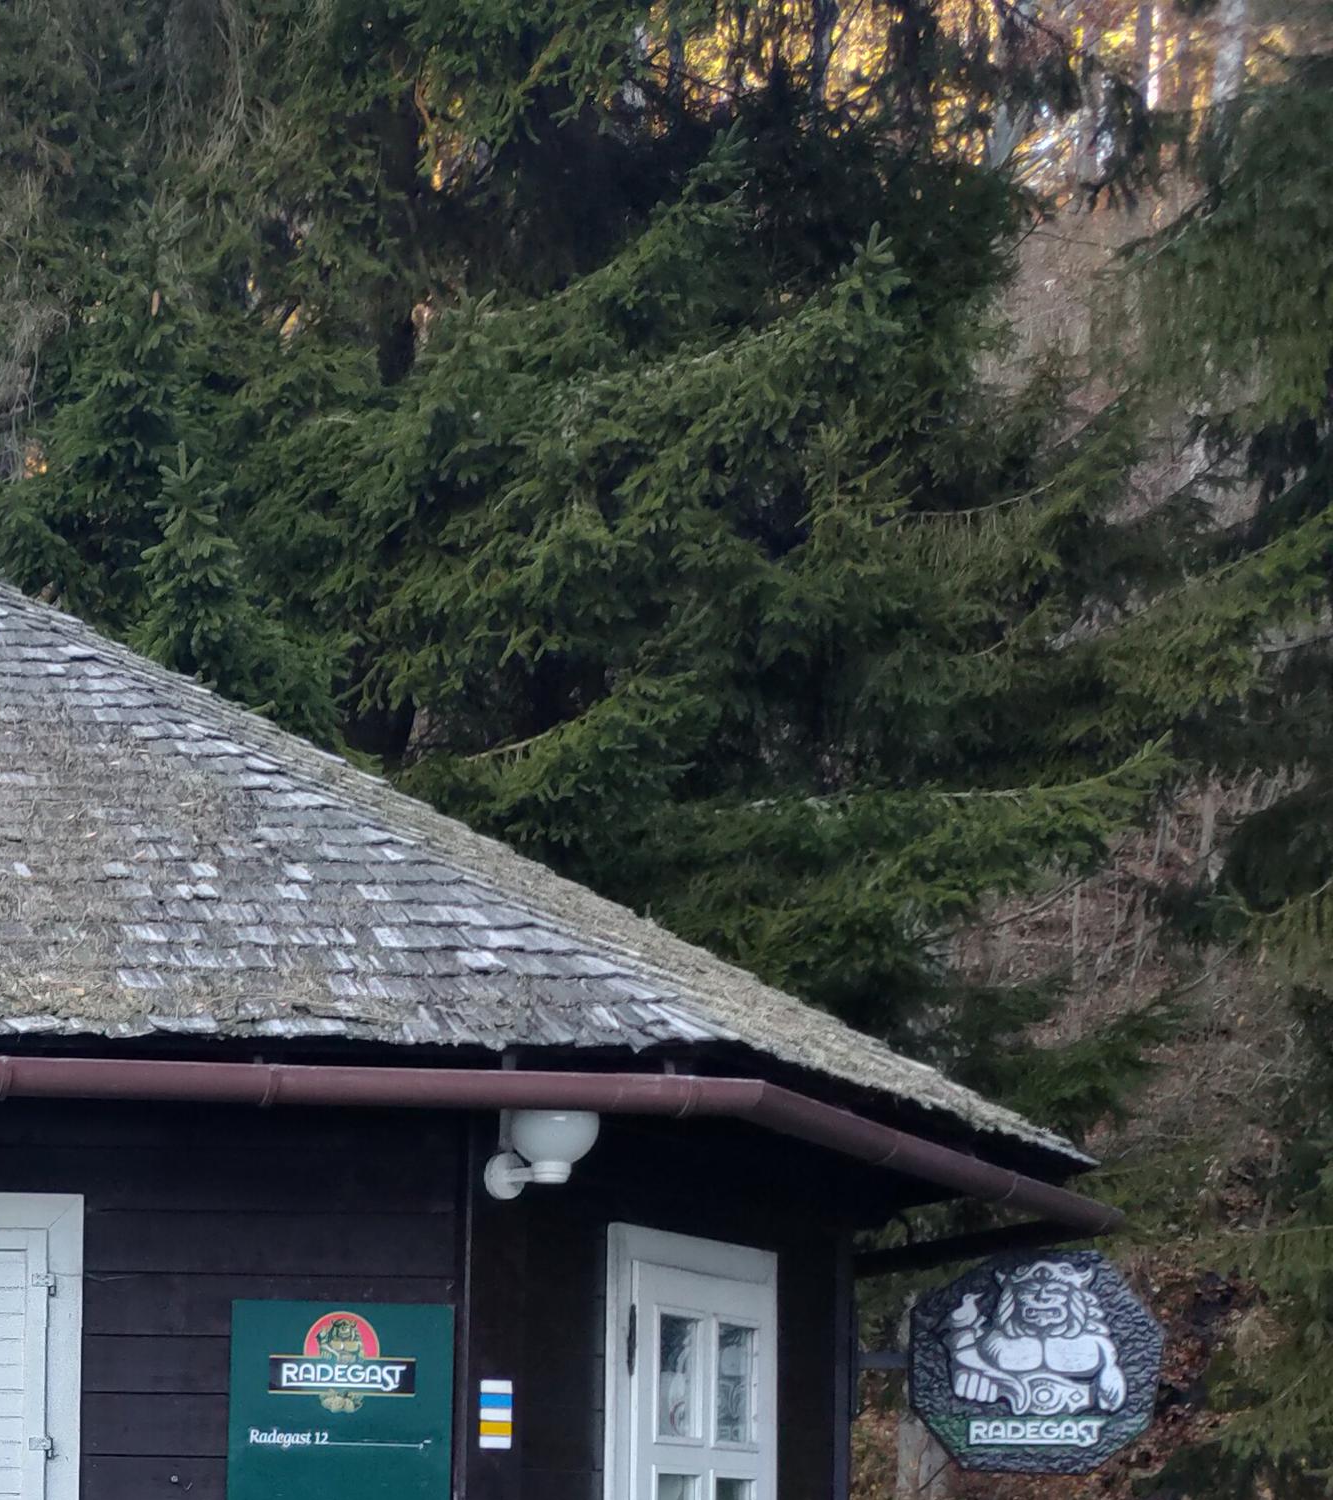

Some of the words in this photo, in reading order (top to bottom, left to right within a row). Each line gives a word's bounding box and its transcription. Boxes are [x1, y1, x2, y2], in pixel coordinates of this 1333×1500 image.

[281, 1362, 407, 1391] RADEGAST
[249, 1428, 312, 1448] Radegast
[314, 1431, 329, 1445] 12
[969, 1420, 1106, 1447] RADEGAST
